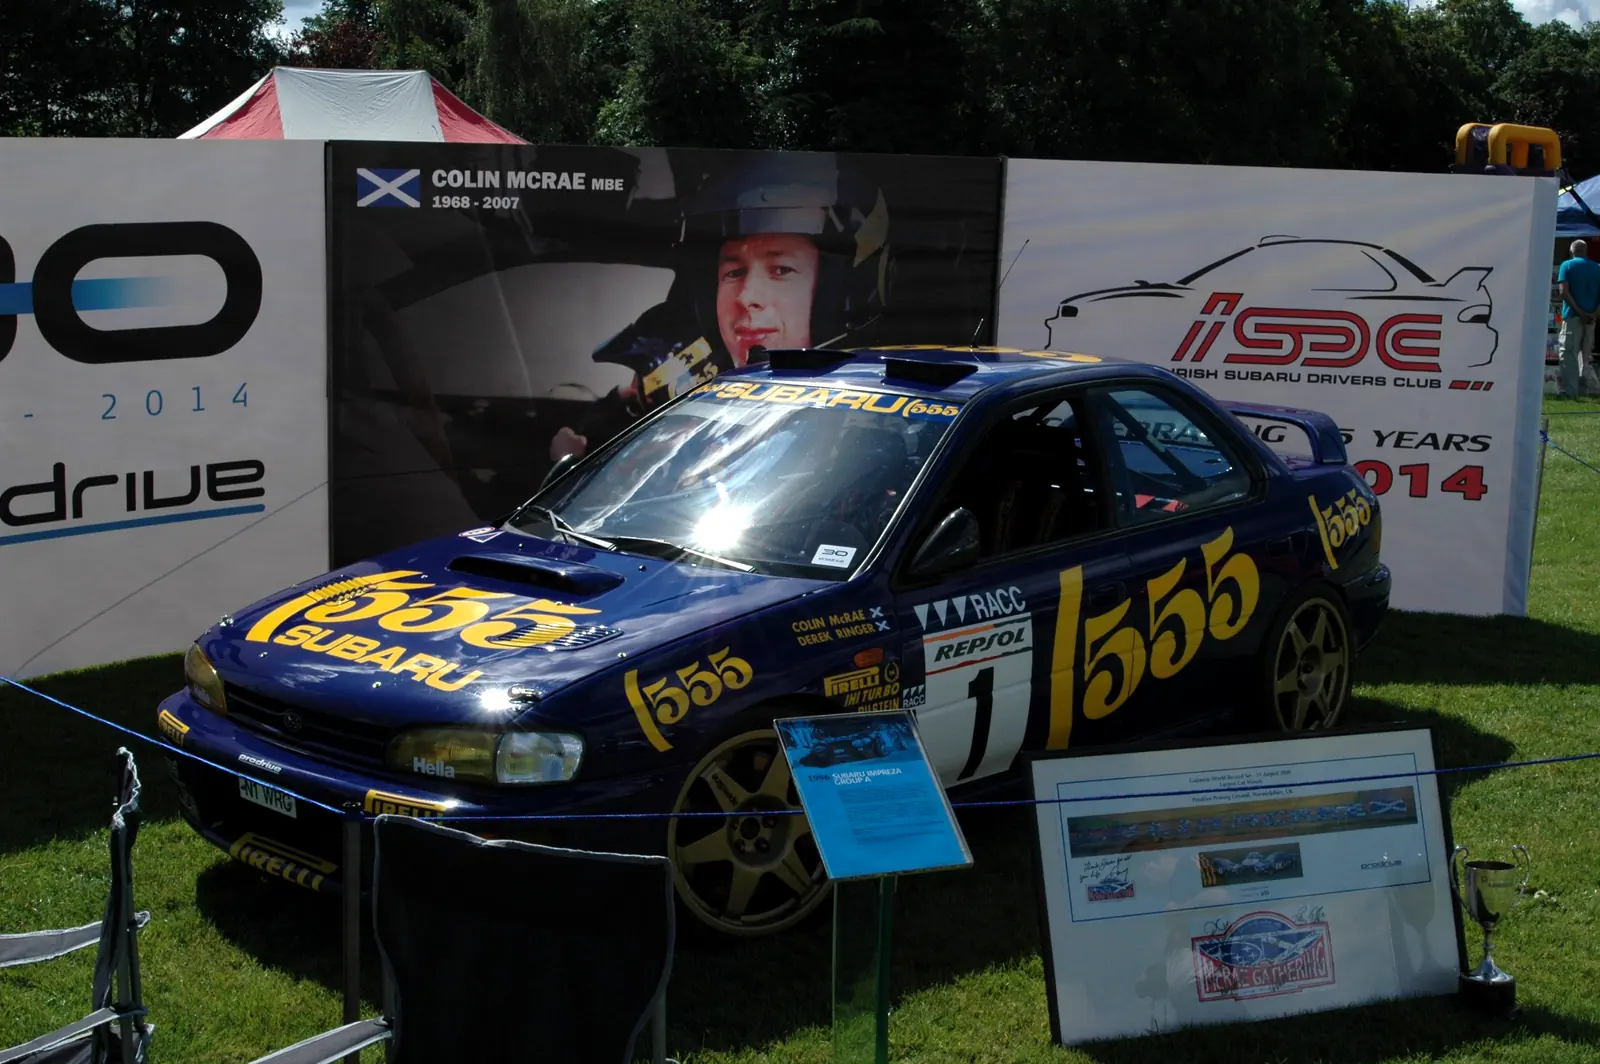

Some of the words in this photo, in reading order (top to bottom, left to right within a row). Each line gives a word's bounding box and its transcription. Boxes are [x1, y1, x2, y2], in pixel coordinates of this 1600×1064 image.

[431, 169, 500, 188] COLIN
[506, 171, 586, 190] MCRAE
[591, 178, 624, 191] MBE
[432, 195, 470, 208] 1968
[482, 196, 520, 209] 2007
[1171, 368, 1218, 379] IRISH
[1224, 370, 1300, 383] SUBARU
[1307, 373, 1386, 386] DRIVERS
[1393, 377, 1441, 388] CLUB
[102, 381, 249, 420] 2014
[716, 382, 904, 414] SUBARU
[910, 401, 960, 417] 555
[1372, 430, 1492, 452] YEARS
[1353, 459, 1488, 501] 014
[1321, 487, 1371, 549] 555
[303, 570, 602, 650] 555
[969, 586, 1027, 619] RACC
[792, 617, 826, 633] COLIN
[829, 609, 866, 627] McRAE
[797, 631, 833, 647] DEREK
[835, 623, 876, 640] RINGER
[1082, 525, 1260, 720] 555
[273, 624, 485, 692] SUBARU
[934, 627, 1025, 663] REPSOL
[642, 646, 754, 726] 555
[824, 666, 880, 697] PIRELLI
[862, 682, 900, 704] TURBO
[903, 694, 925, 709] RACC
[957, 667, 995, 782] 1
[238, 753, 283, 773] prodrive
[413, 756, 455, 778] Hella
[832, 769, 866, 779] SUBARU
[867, 767, 903, 777] IMPREZA
[834, 777, 863, 785] GROUP
[229, 831, 338, 893] PIRELLI
[1253, 942, 1327, 986] GATHERING
